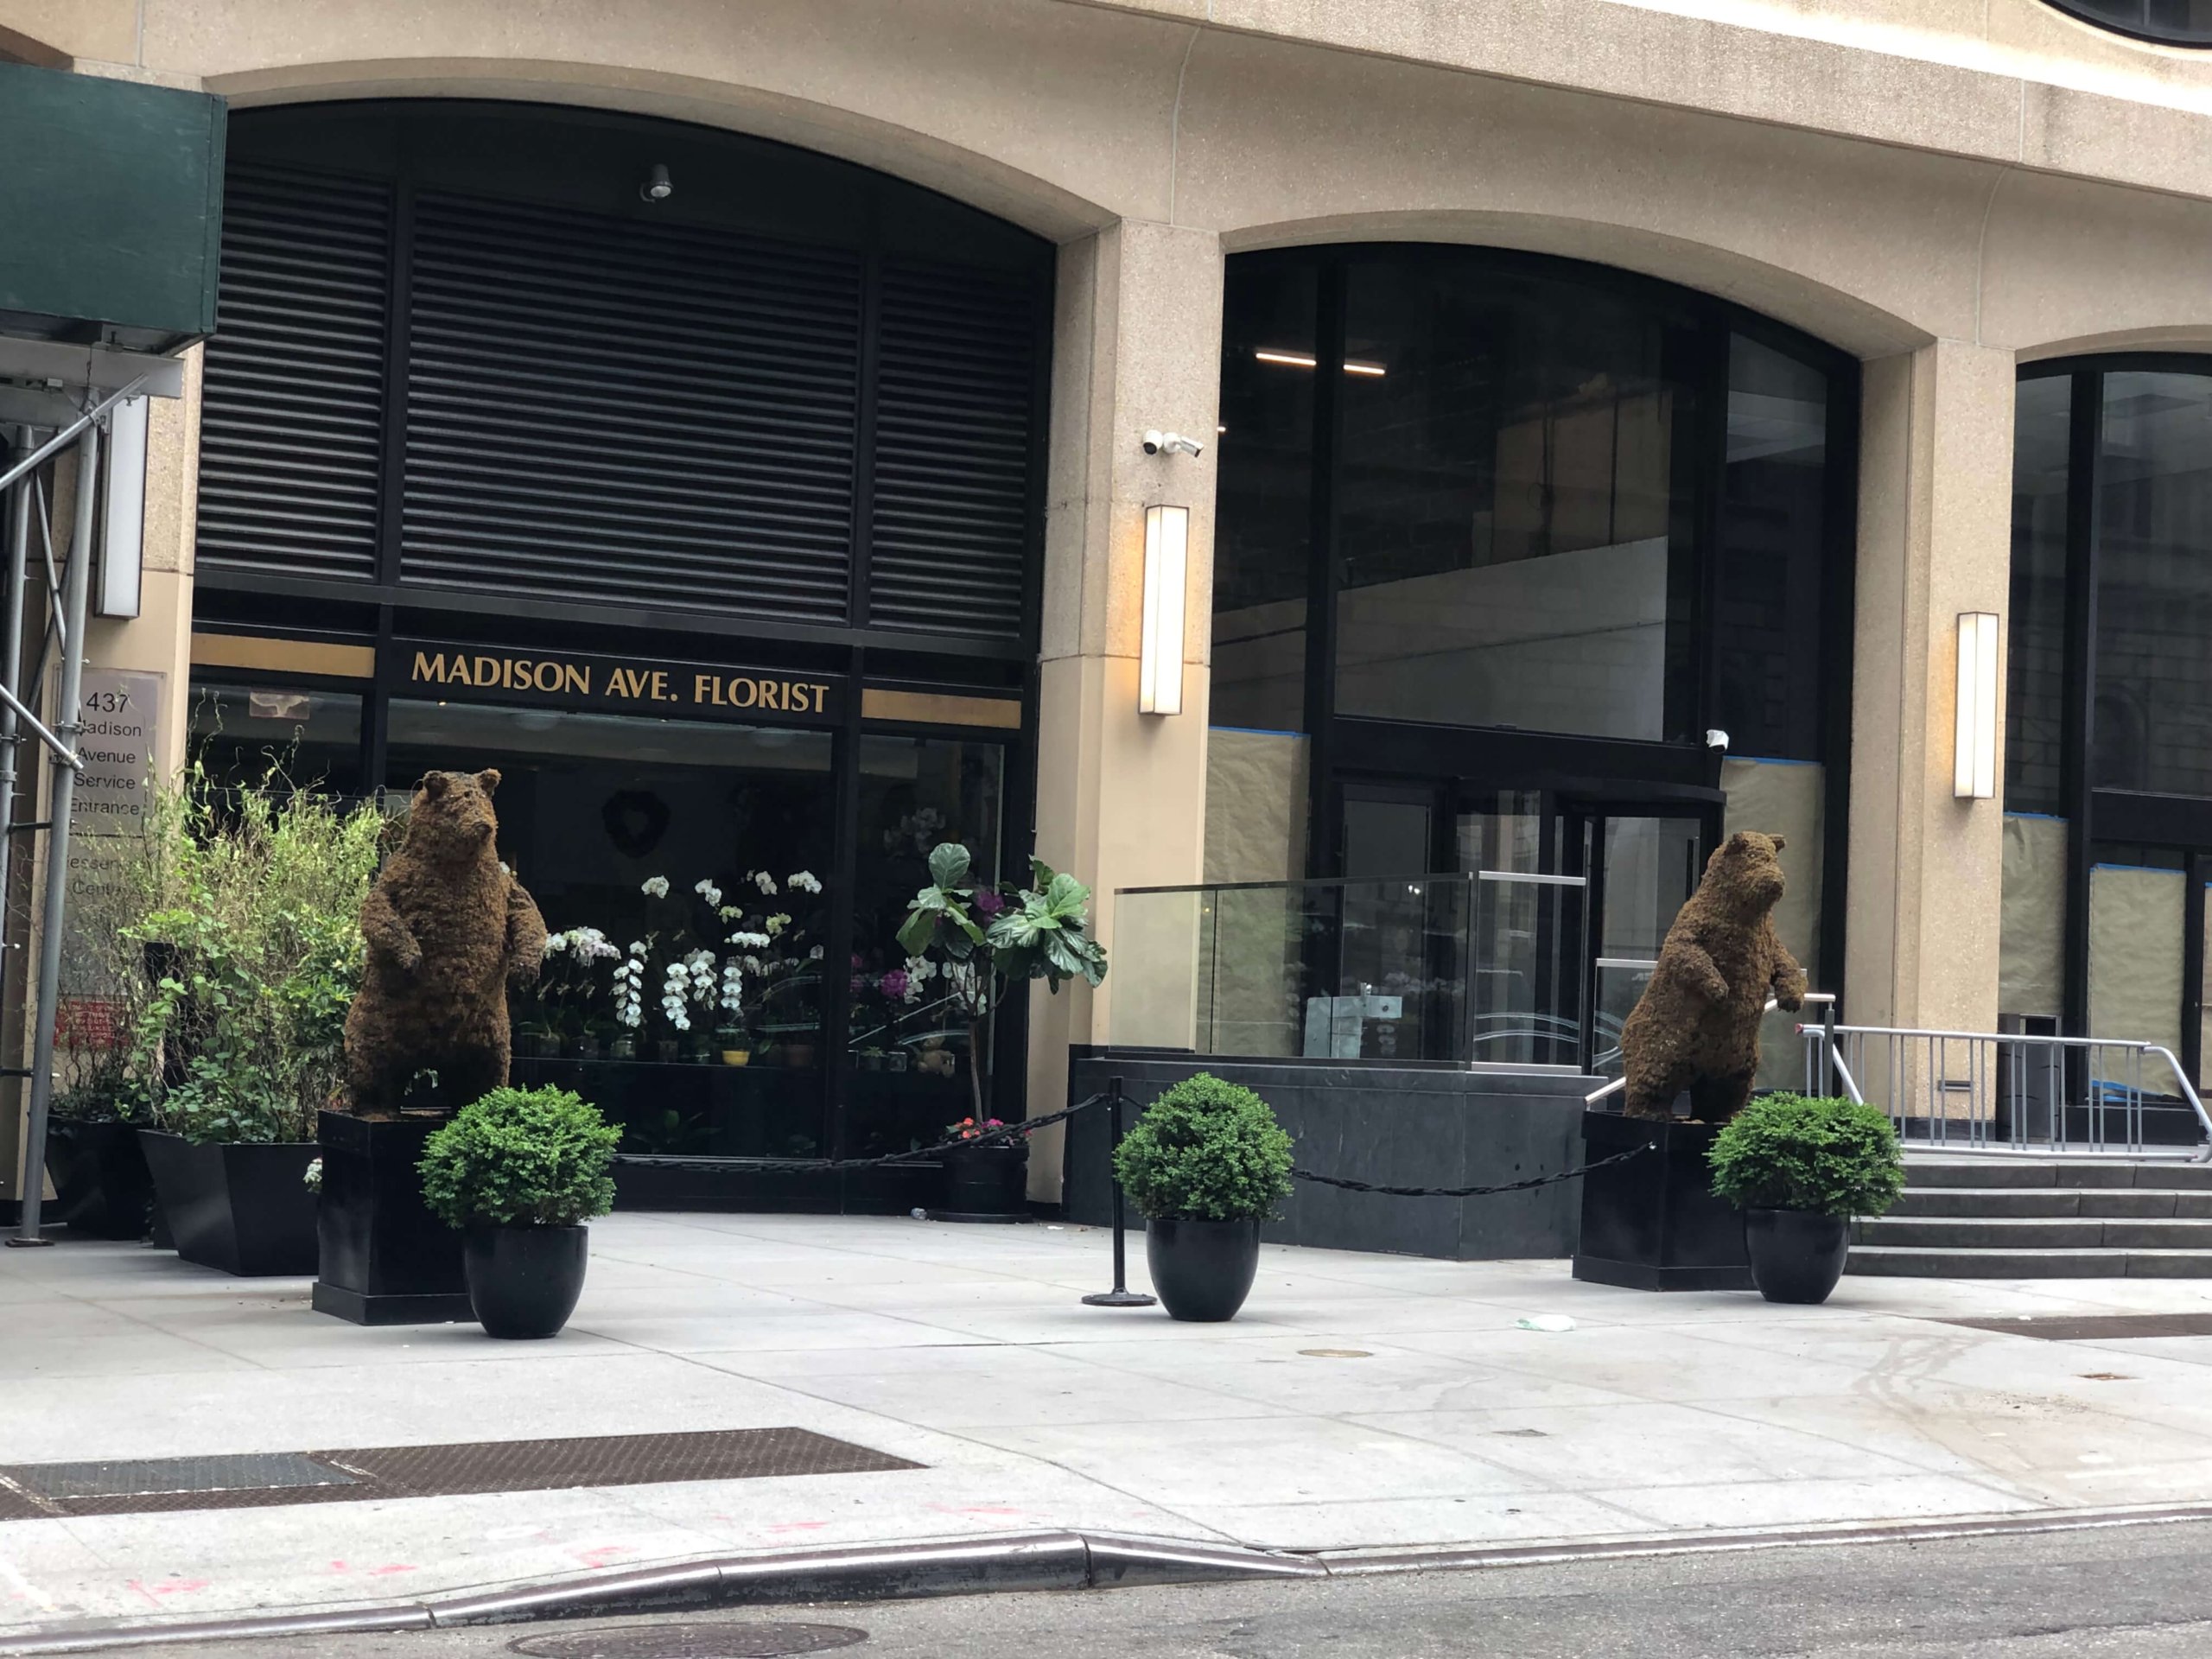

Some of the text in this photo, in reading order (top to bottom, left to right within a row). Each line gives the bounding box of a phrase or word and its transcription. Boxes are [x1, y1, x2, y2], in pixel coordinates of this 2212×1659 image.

[411, 652, 830, 714] MADISON AVE. FLORIST
[86, 691, 130, 714] 437
[78, 747, 137, 764] Avenue
[73, 772, 137, 790] Service
